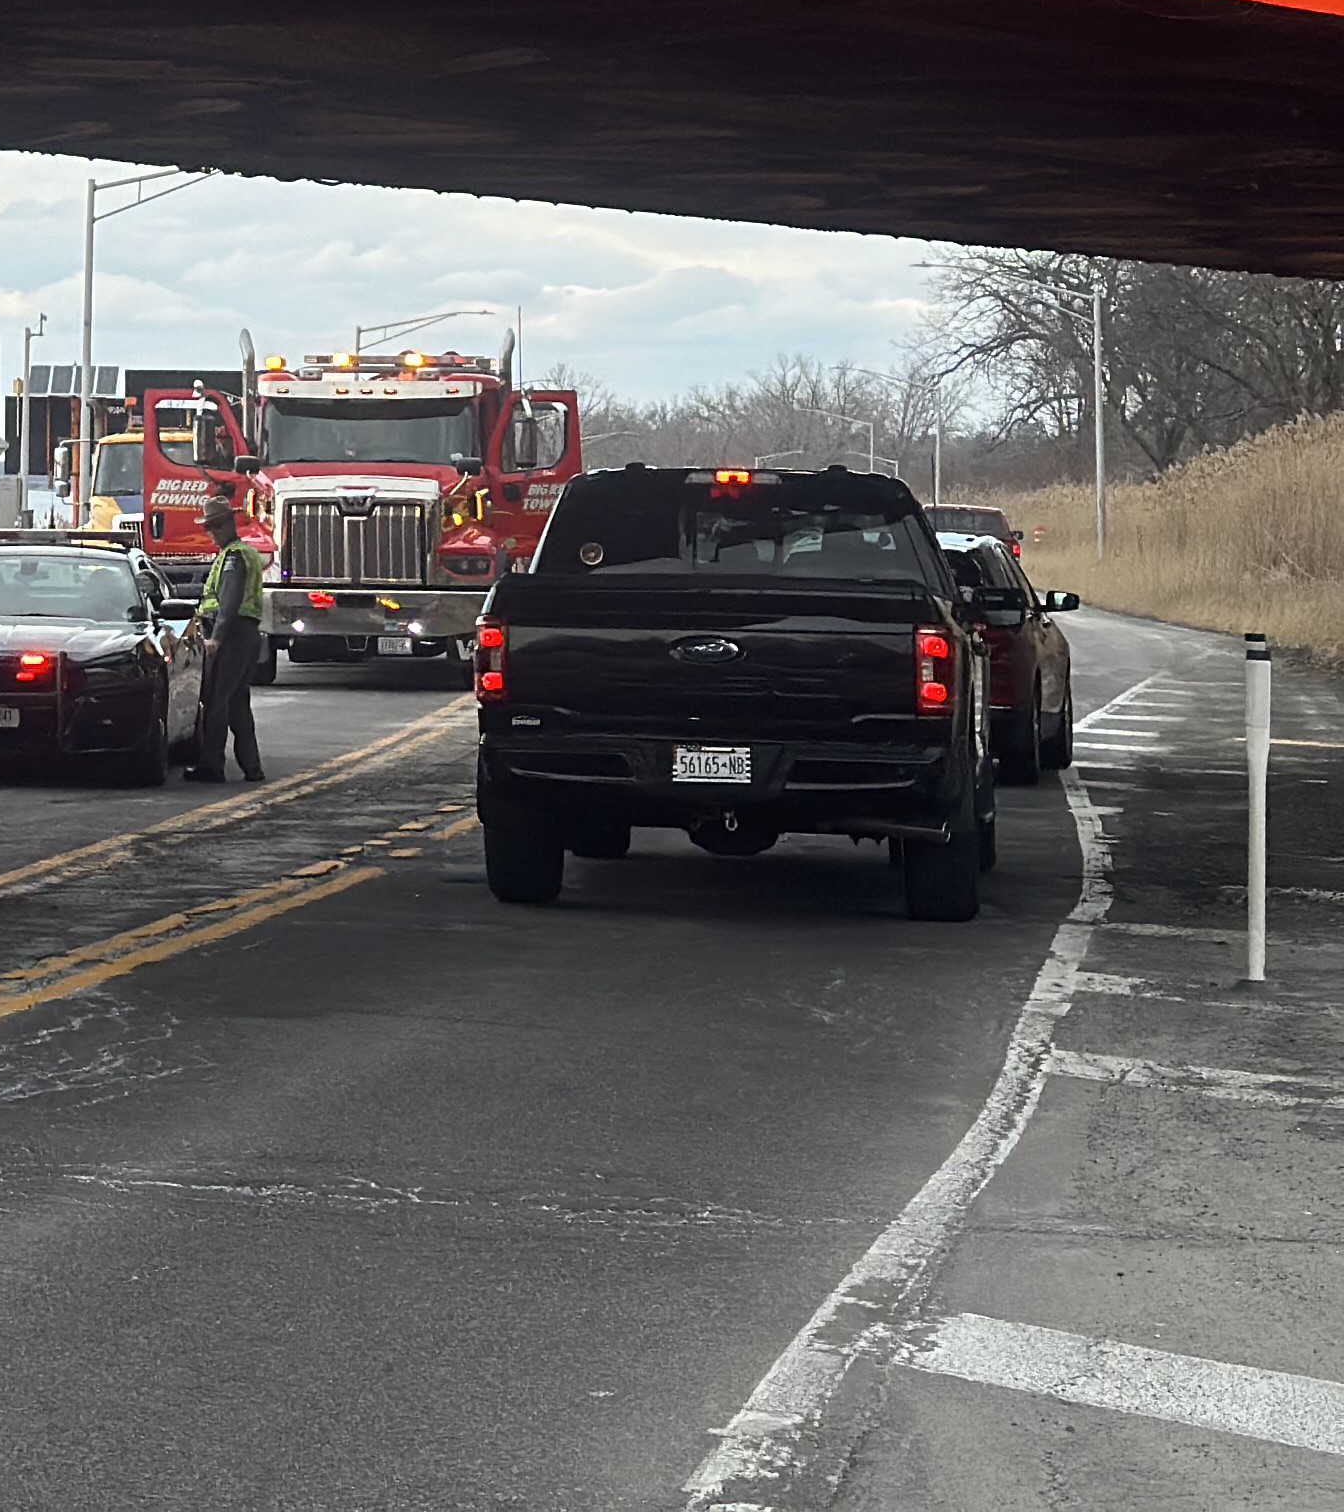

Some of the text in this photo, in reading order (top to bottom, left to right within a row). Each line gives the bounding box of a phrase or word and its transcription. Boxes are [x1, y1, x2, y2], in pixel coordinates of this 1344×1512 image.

[156, 479, 209, 492] BIG RED
[150, 492, 211, 506] TOWING
